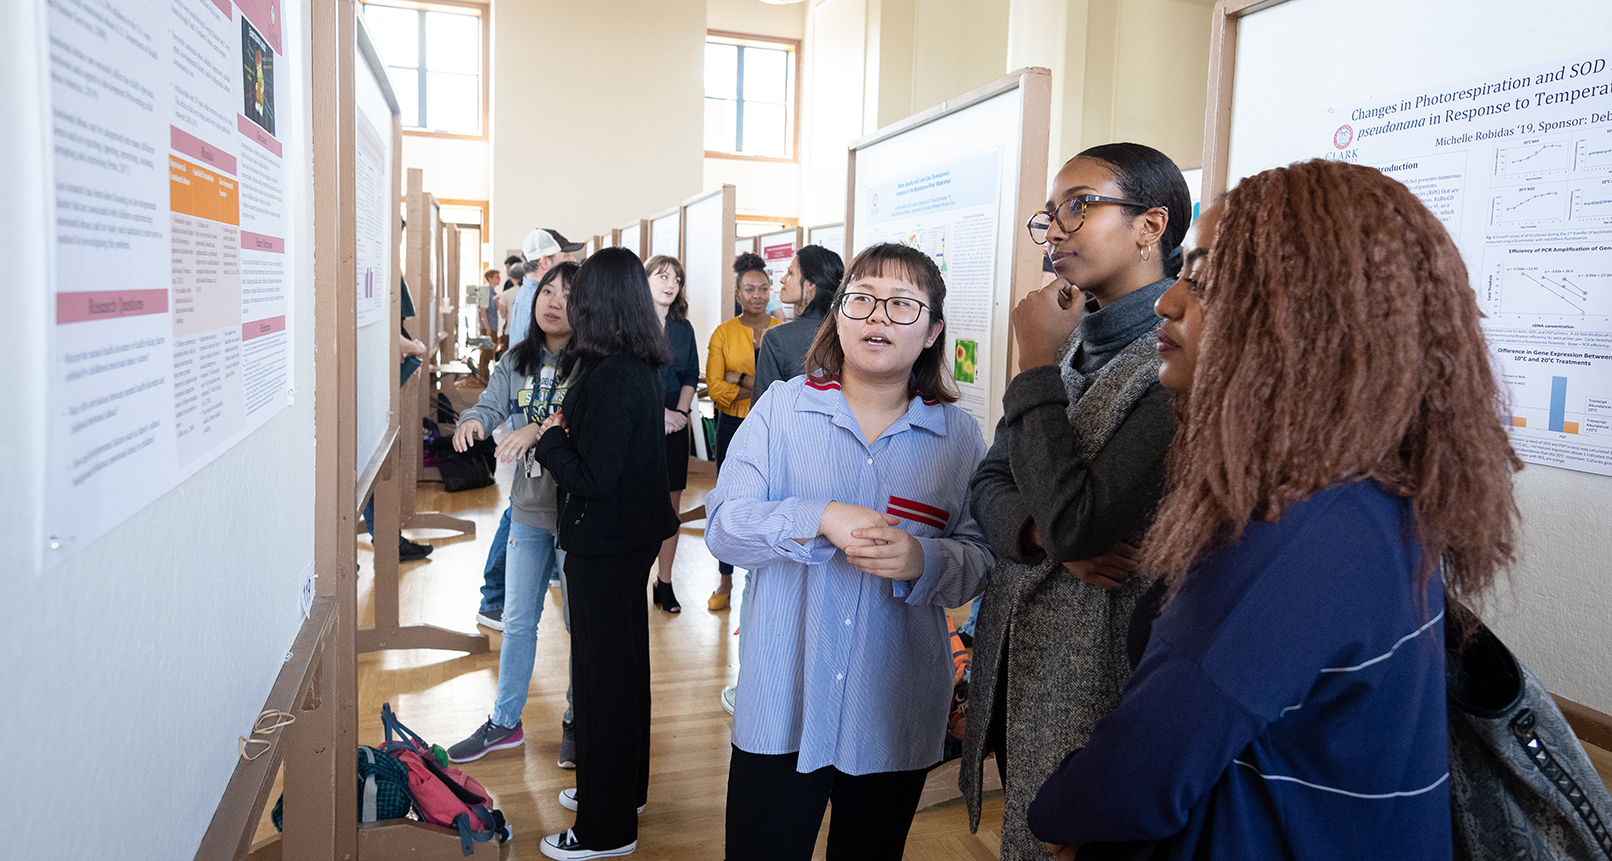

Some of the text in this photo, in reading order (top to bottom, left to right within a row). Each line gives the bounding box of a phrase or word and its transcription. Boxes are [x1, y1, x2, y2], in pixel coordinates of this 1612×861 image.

[1351, 59, 1606, 121] Changes in Photorespiration and SOD
[1357, 117, 1426, 141] pseudonana
[1429, 114, 1441, 125] in
[1445, 101, 1511, 122] Response
[1515, 98, 1530, 110] to
[1435, 133, 1473, 147] Michelle
[1475, 128, 1514, 142] Robidas
[1538, 117, 1587, 133] Sponsor:
[1325, 149, 1358, 161] CLARK
[1377, 161, 1418, 173] troduction
[1550, 351, 1583, 359] Expression
